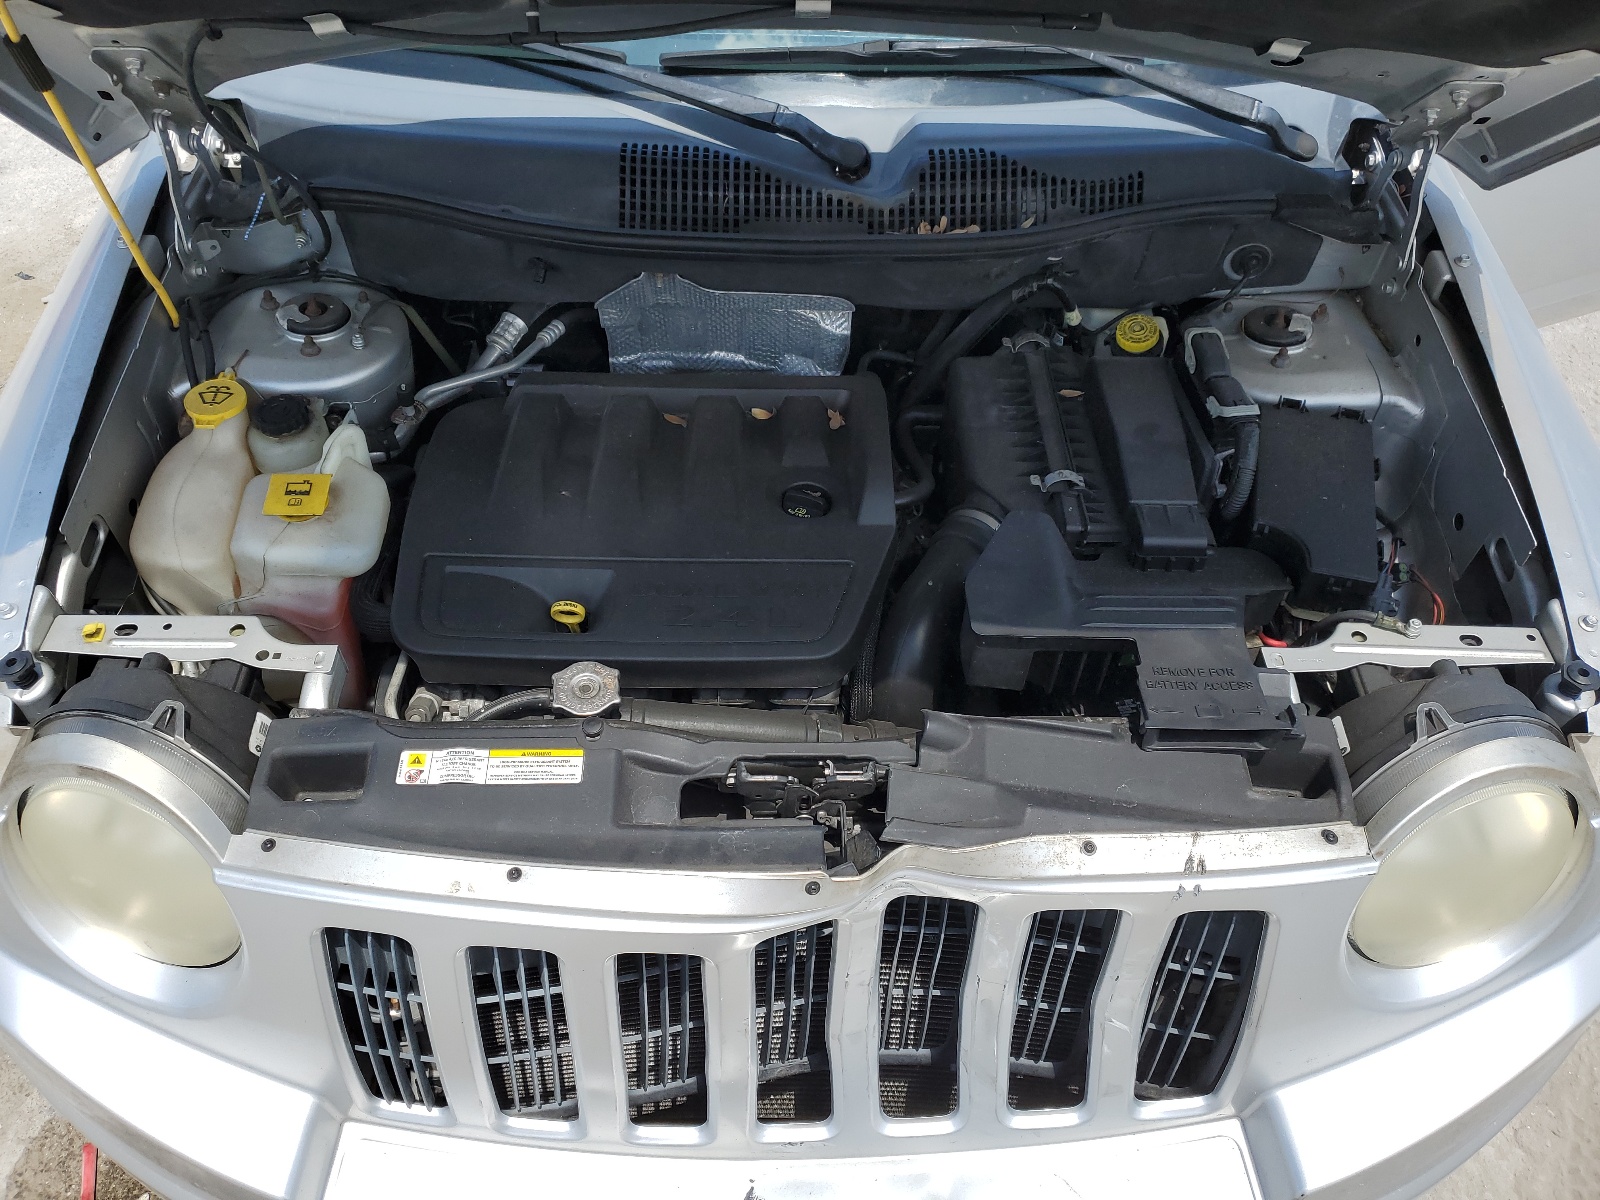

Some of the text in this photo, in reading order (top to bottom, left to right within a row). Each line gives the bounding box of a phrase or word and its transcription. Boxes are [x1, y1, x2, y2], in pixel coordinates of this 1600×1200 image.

[1152, 666, 1235, 677] REMOVE FOR
[1145, 680, 1254, 691] BATTERY ACCESS
